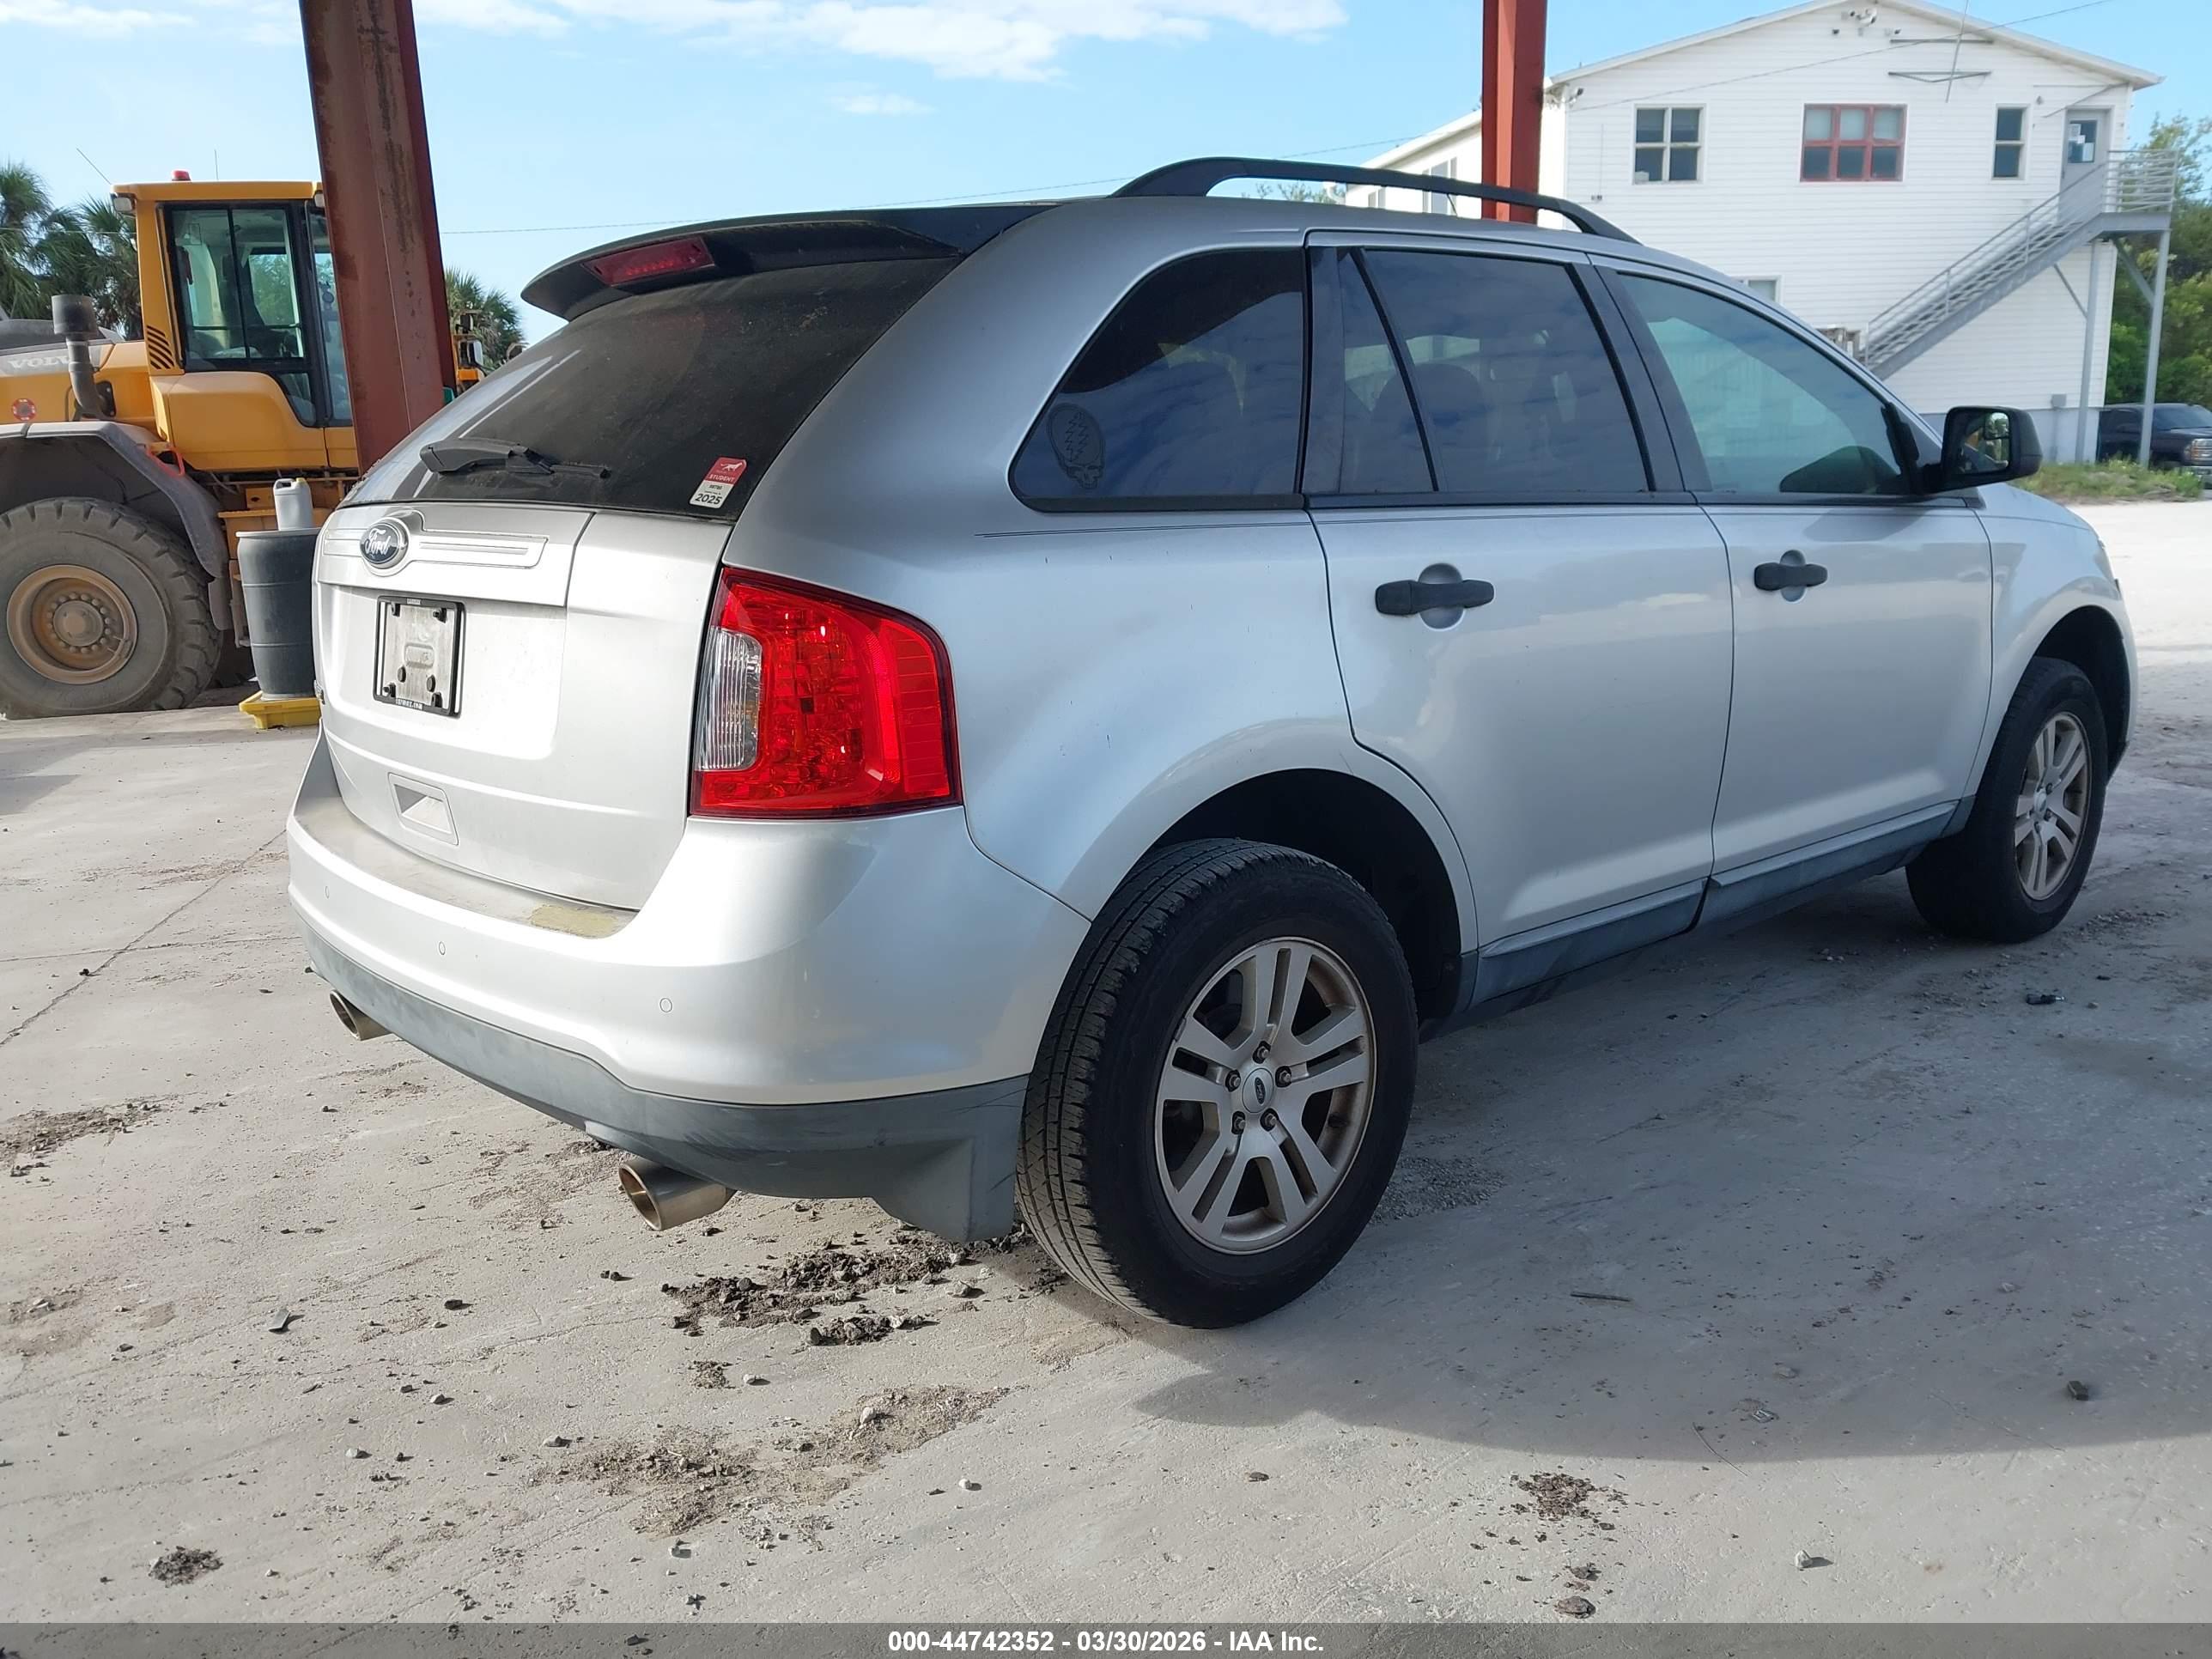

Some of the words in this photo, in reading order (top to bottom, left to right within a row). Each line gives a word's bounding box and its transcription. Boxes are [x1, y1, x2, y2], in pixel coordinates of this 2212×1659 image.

[8, 356, 69, 368] VOLV
[708, 473, 735, 483] STUDENT
[695, 493, 723, 505] 2025
[364, 528, 392, 556] Ford
